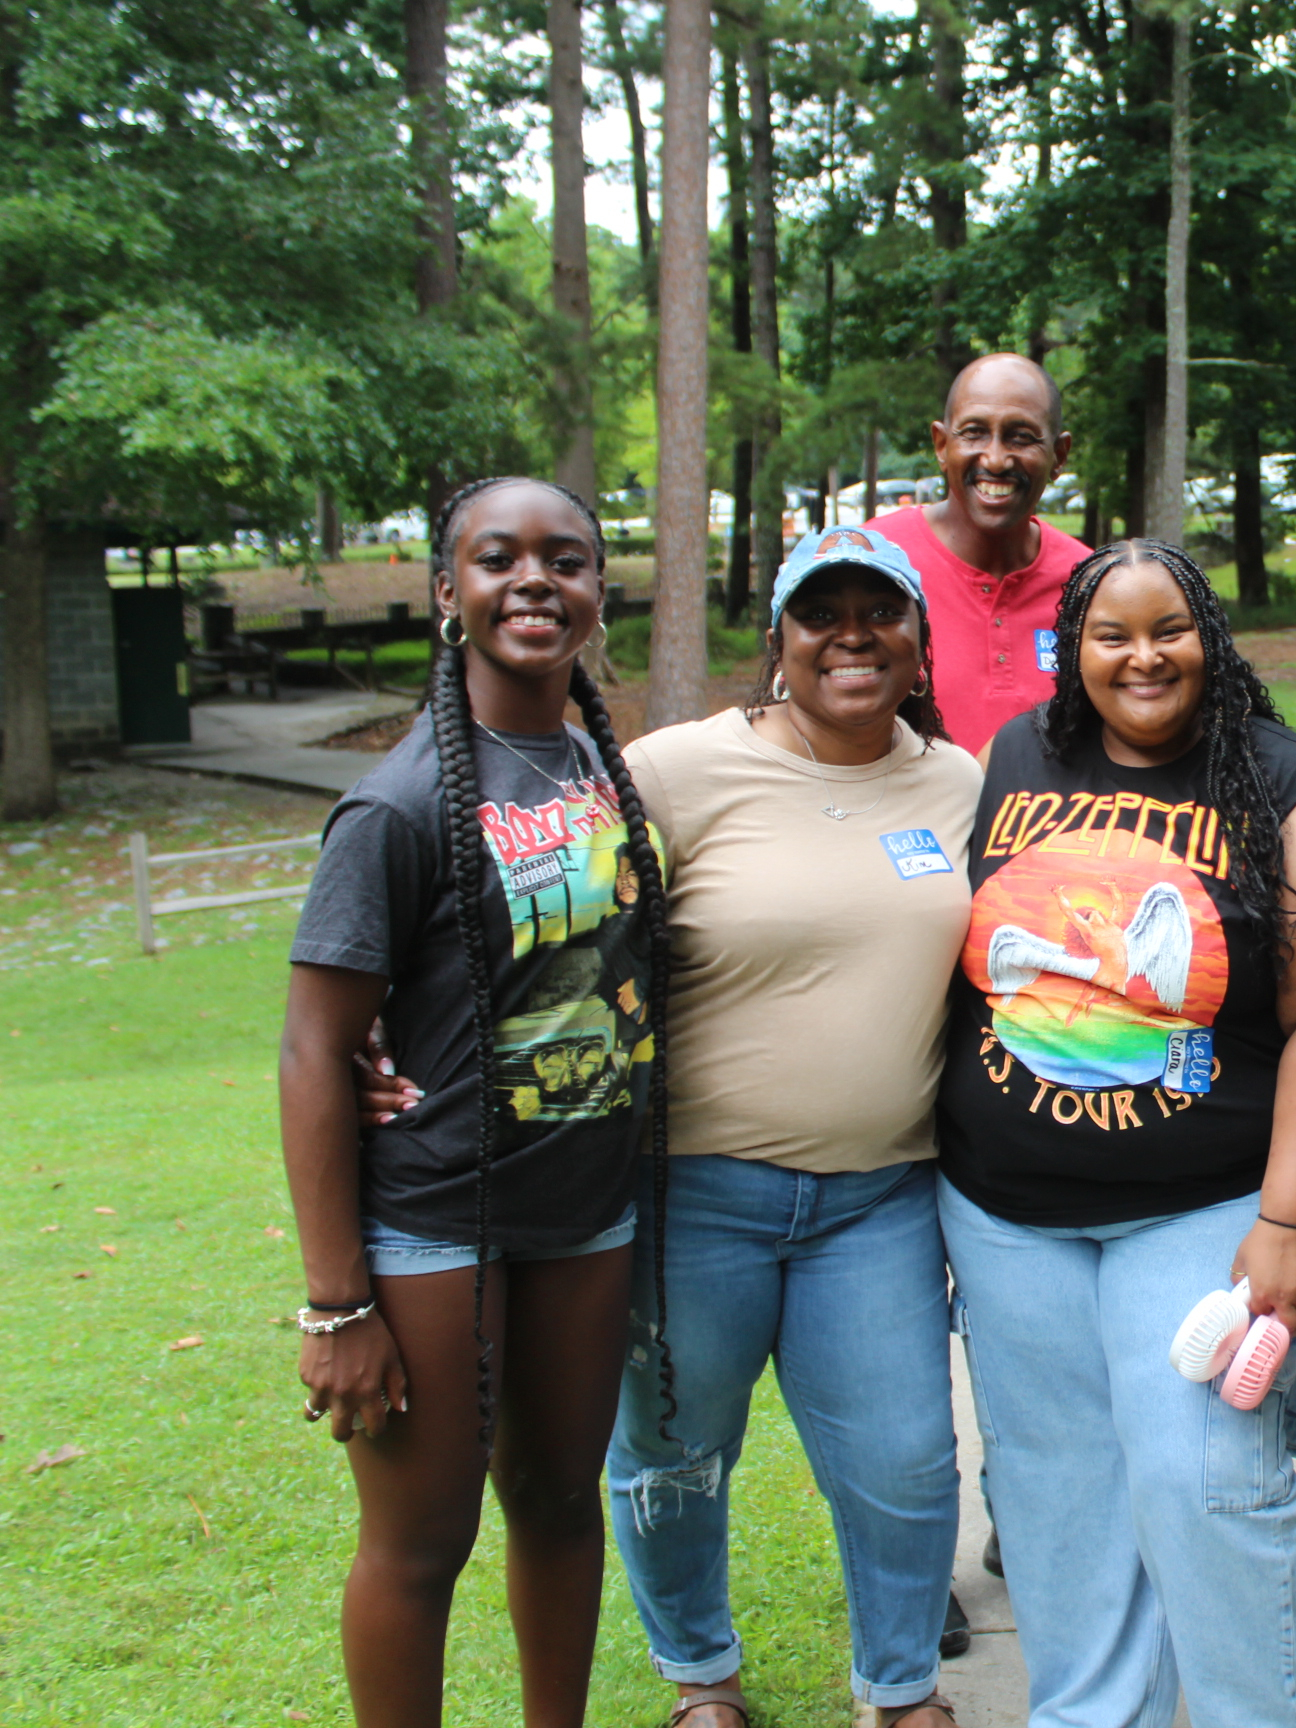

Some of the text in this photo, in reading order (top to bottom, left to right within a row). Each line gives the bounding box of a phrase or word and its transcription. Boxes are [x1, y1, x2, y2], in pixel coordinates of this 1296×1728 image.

[510, 854, 556, 875] PARENTAL
[514, 863, 559, 888] ADVISORY
[516, 883, 540, 897] EXPLICIT
[1168, 1037, 1184, 1074] Ciara
[1189, 1031, 1210, 1090] hello
[1029, 1076, 1143, 1131] TOUR
